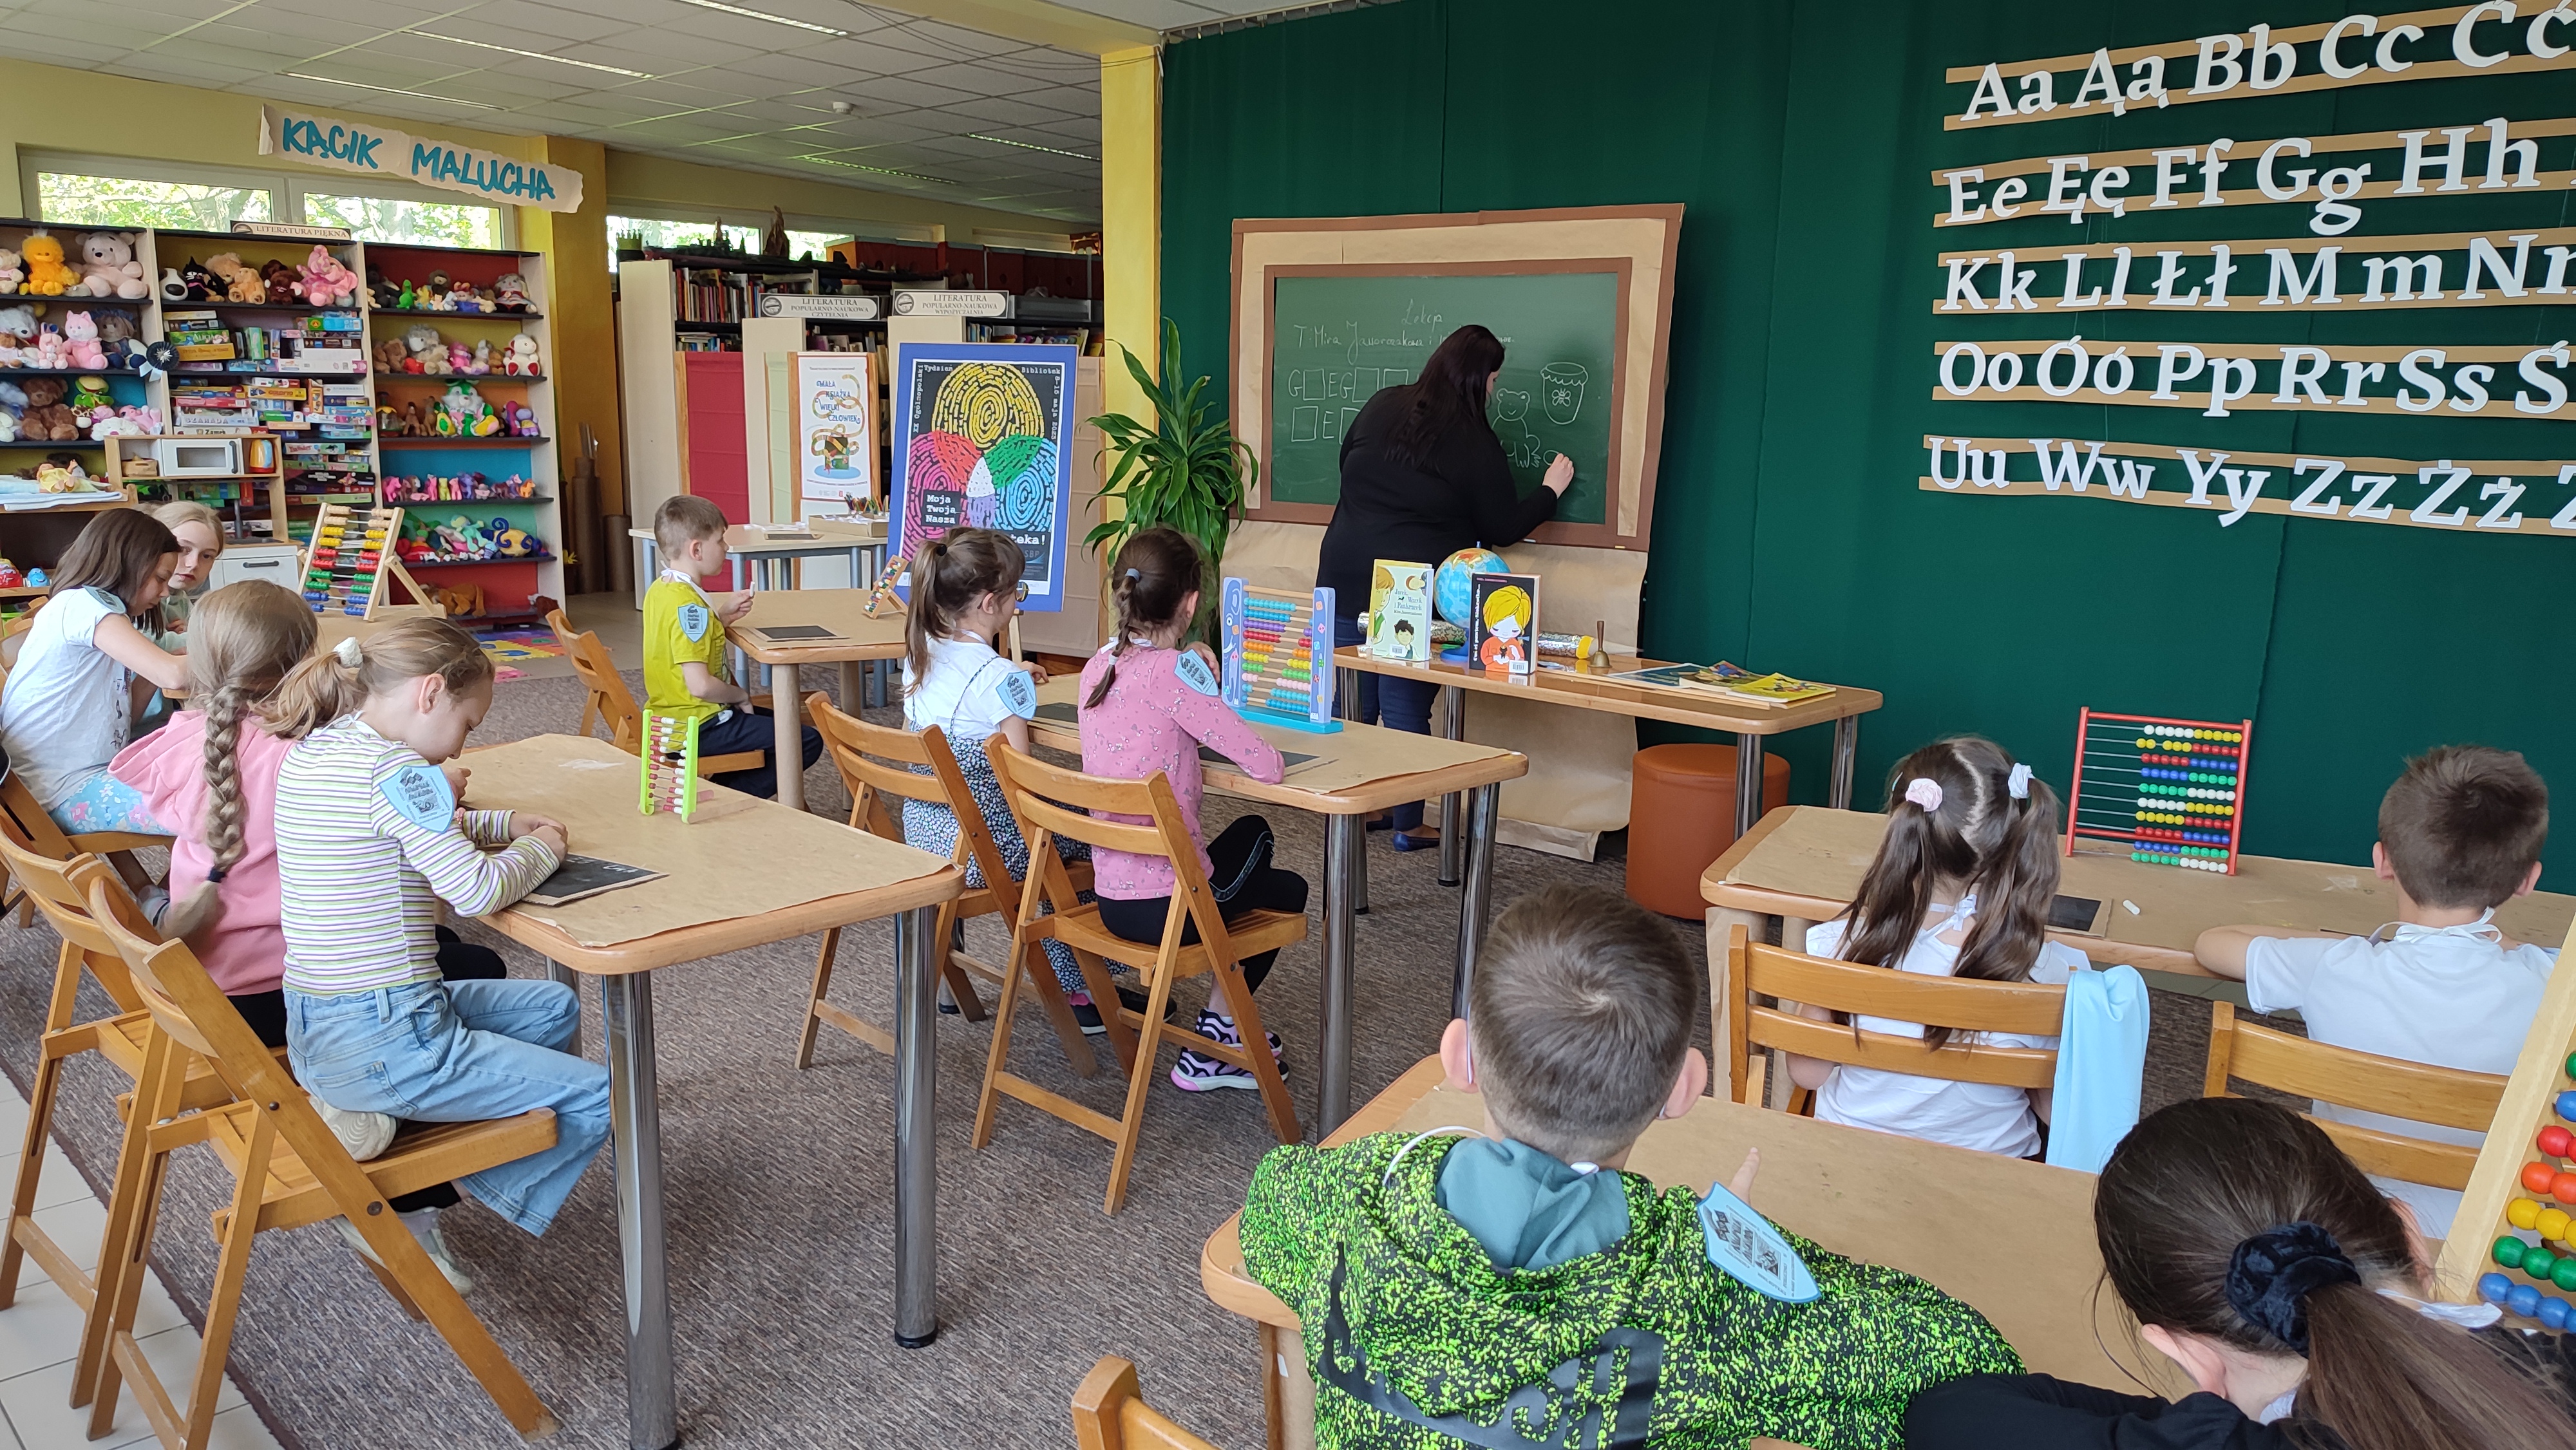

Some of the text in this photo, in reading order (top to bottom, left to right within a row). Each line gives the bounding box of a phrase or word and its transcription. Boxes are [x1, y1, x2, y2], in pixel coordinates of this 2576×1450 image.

[1960, 62, 2058, 121] Aa
[2069, 46, 2170, 117] Ąą
[2187, 23, 2297, 95] Bb
[2320, 14, 2424, 79] Cc
[282, 117, 556, 202] KĄCIK MALUCHA
[1943, 117, 2541, 236] Ee Ęę Ff Gg Hh
[256, 225, 346, 238] LITERATURA PIĘKNA
[1940, 251, 2038, 310] Kk
[2056, 246, 2132, 307] Ll
[2148, 244, 2237, 307] Łł
[802, 297, 858, 306] LITERATURA
[934, 294, 987, 302] LITERATURA
[1401, 298, 1443, 334] Lekcja
[1021, 366, 1061, 375] Bibliotek
[1939, 342, 2023, 396] Oo
[2036, 335, 2134, 397] Óó
[2149, 344, 2257, 417] Pp
[2271, 346, 2385, 406] Rr
[2396, 348, 2496, 412] Ss
[1928, 437, 2010, 489] Uu
[2028, 438, 2156, 499] Ww
[2176, 449, 2271, 527] Yy
[2289, 458, 2397, 520] Zz
[926, 494, 951, 505] Moja
[926, 504, 956, 514] Twoja
[925, 514, 956, 524] Nasza
